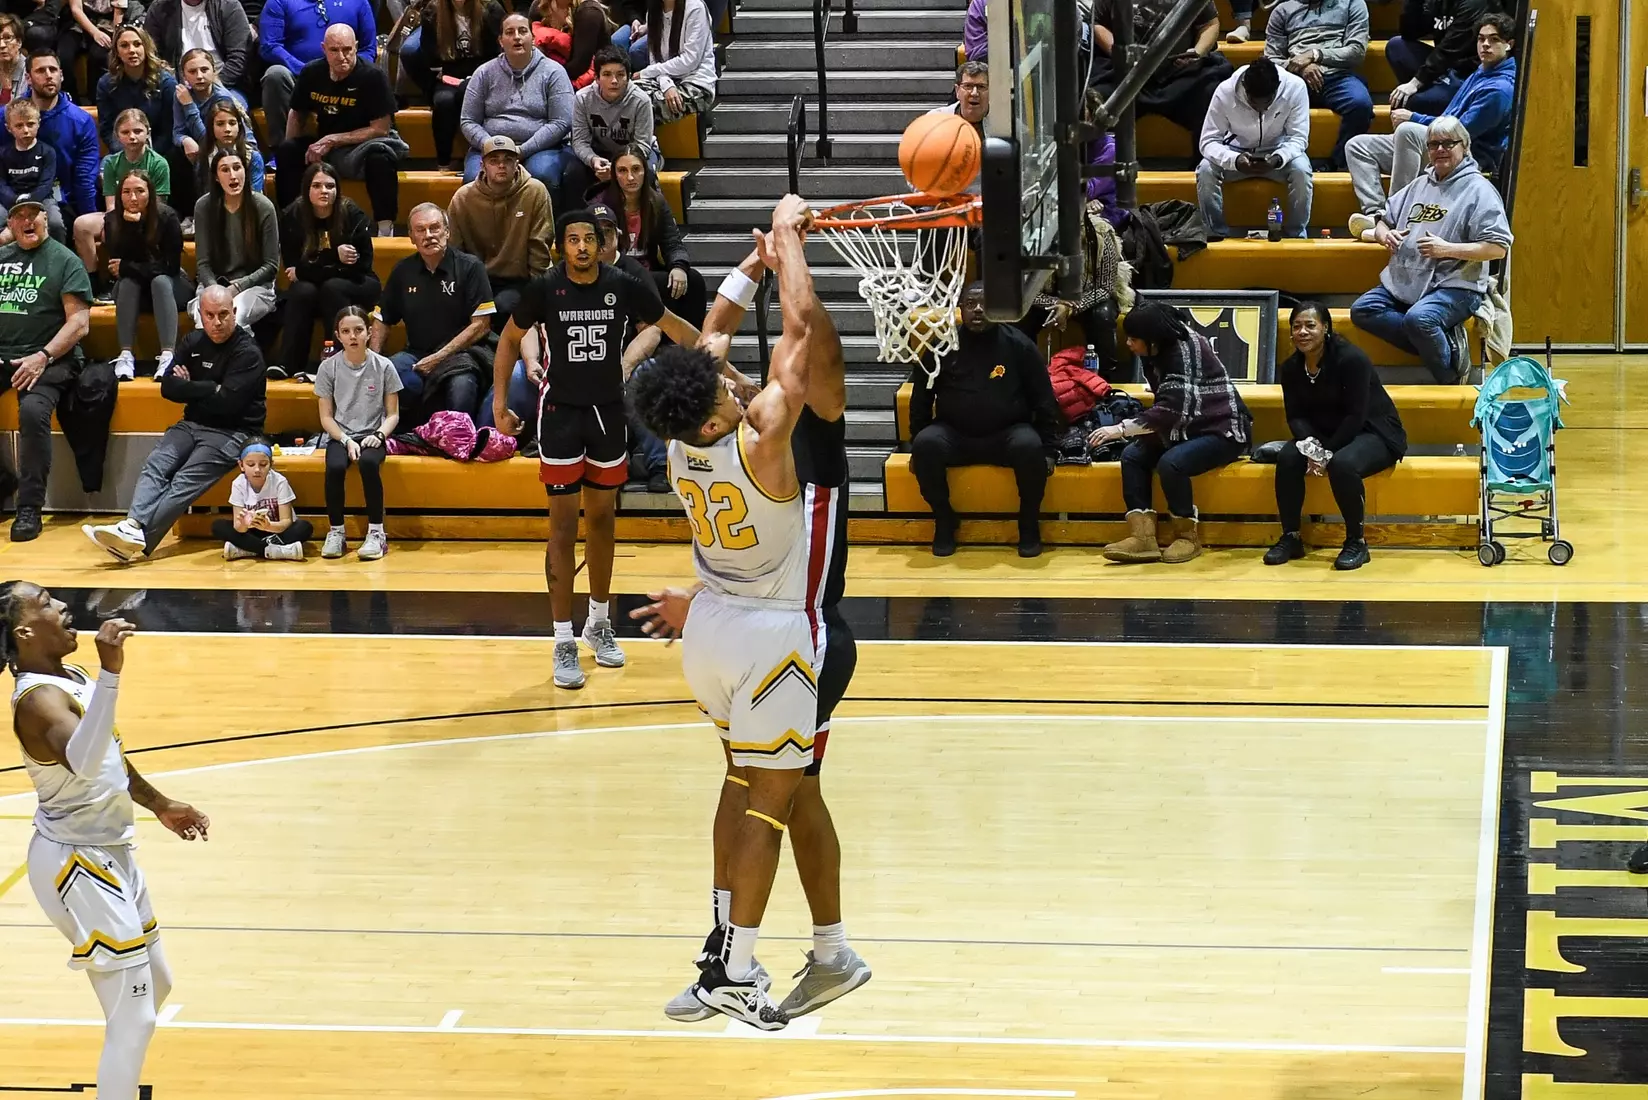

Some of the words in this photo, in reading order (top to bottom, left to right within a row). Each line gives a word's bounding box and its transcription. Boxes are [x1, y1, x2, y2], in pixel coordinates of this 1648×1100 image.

[310, 91, 340, 105] SHOW
[340, 96, 357, 107] ME
[23, 262, 34, 276] A
[0, 273, 47, 289] HILLY
[558, 309, 615, 322] WARRIORS
[567, 324, 608, 362] 25
[686, 455, 713, 469] PSAC
[677, 477, 760, 551] 32
